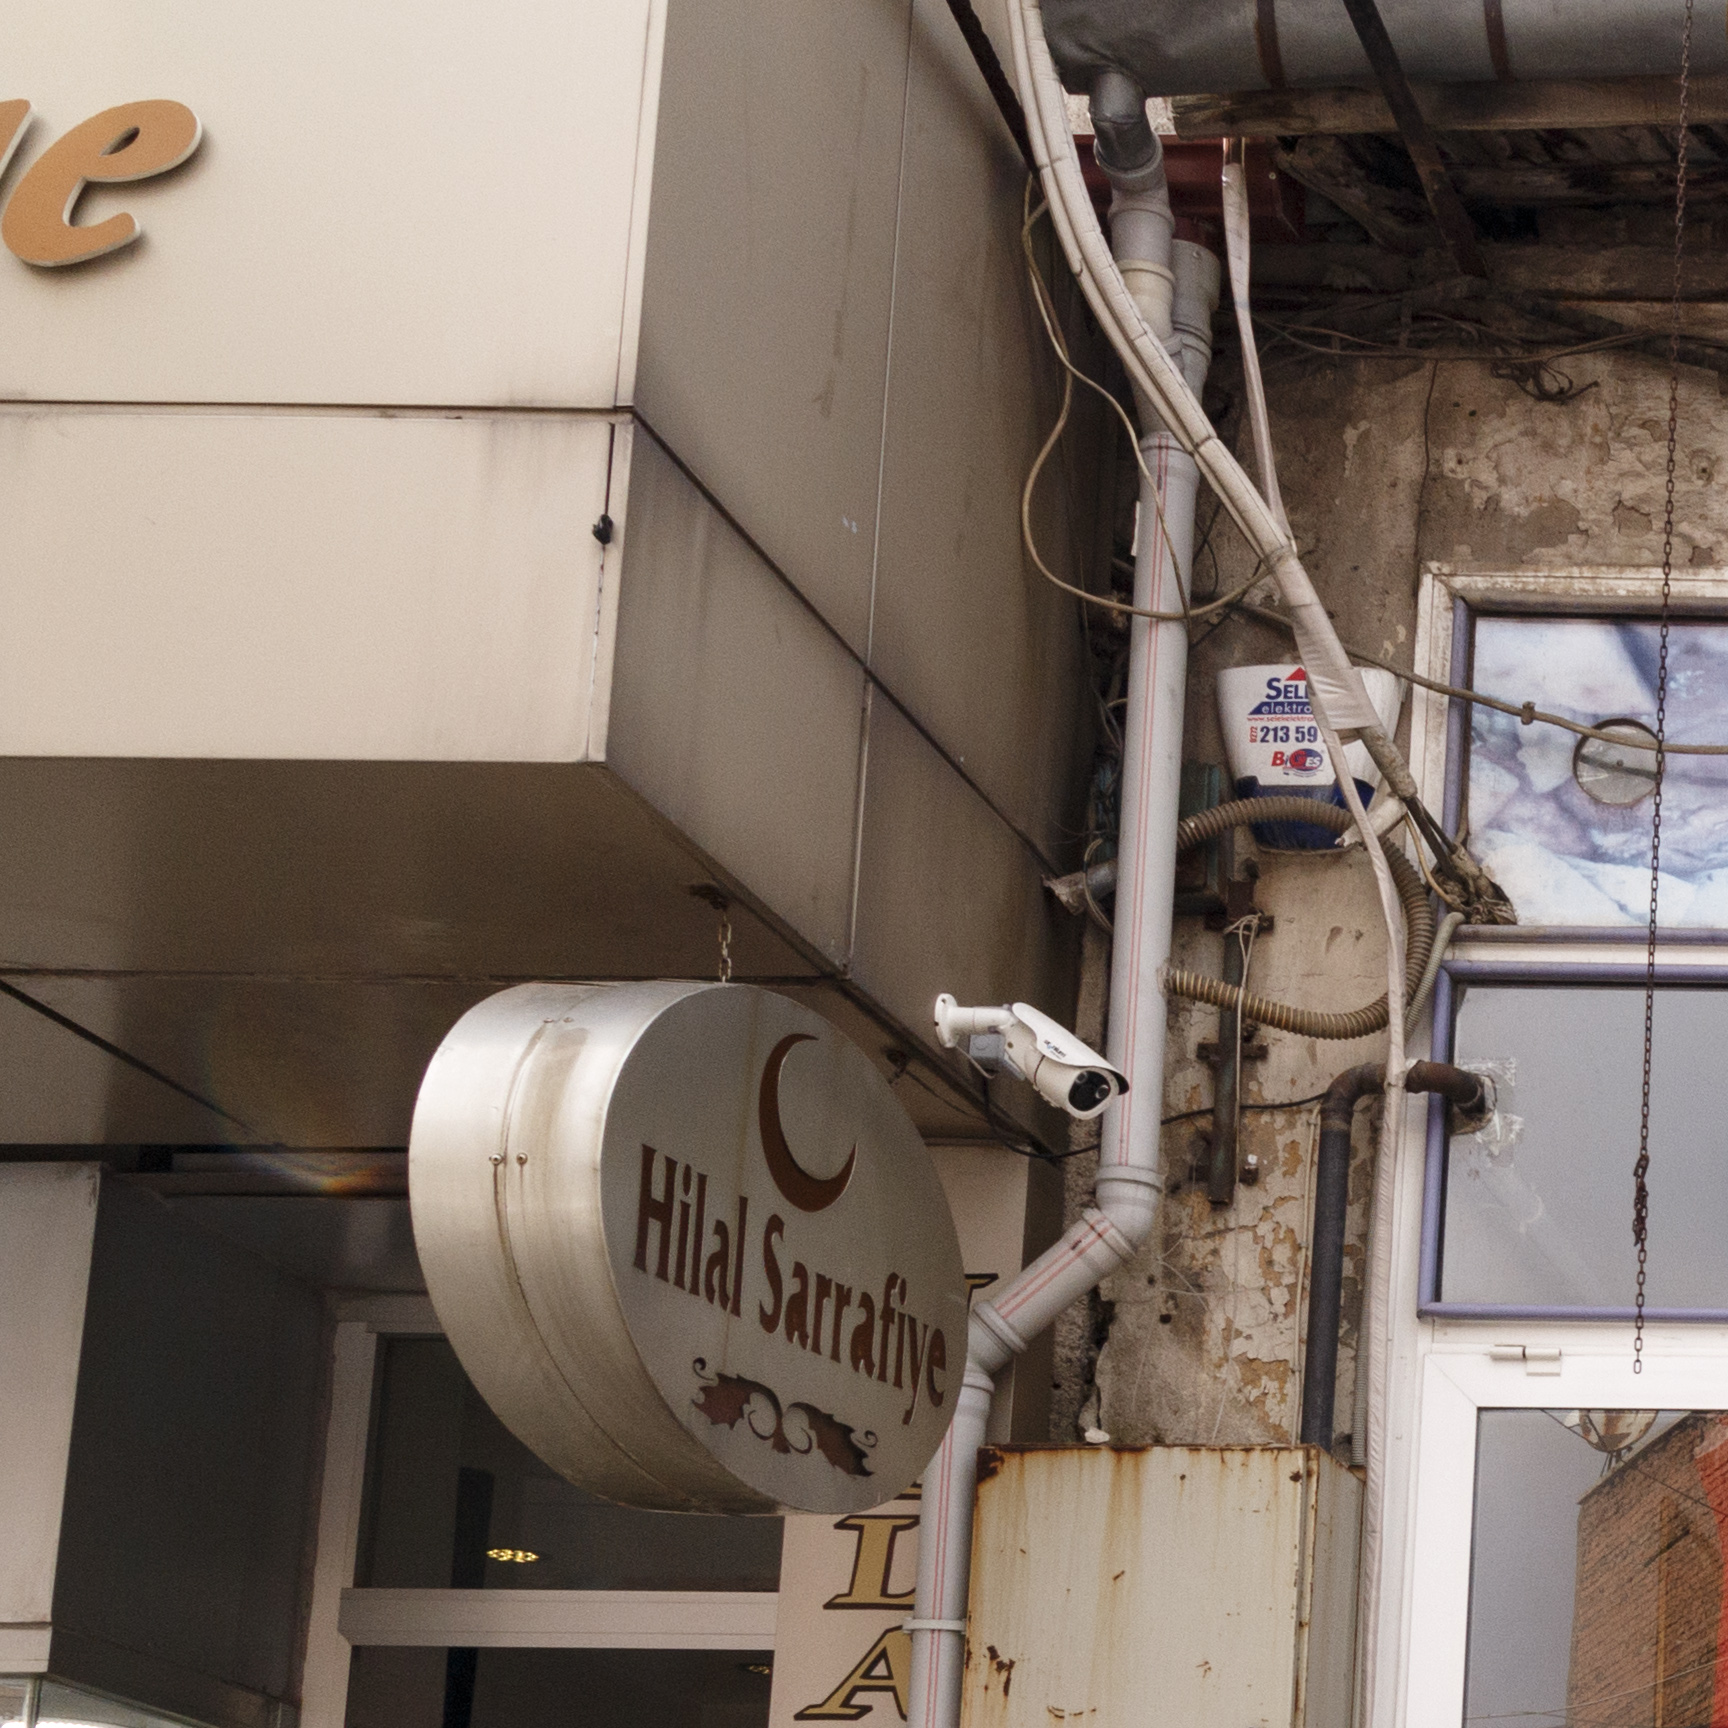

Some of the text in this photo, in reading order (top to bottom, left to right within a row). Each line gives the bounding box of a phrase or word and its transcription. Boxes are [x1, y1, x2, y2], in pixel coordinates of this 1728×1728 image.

[0, 98, 203, 268] e
[1260, 726, 1290, 743] 213
[1295, 726, 1318, 743] 59
[1261, 702, 1312, 714] elektro
[633, 1142, 947, 1426] Hilal Sarrafiye
